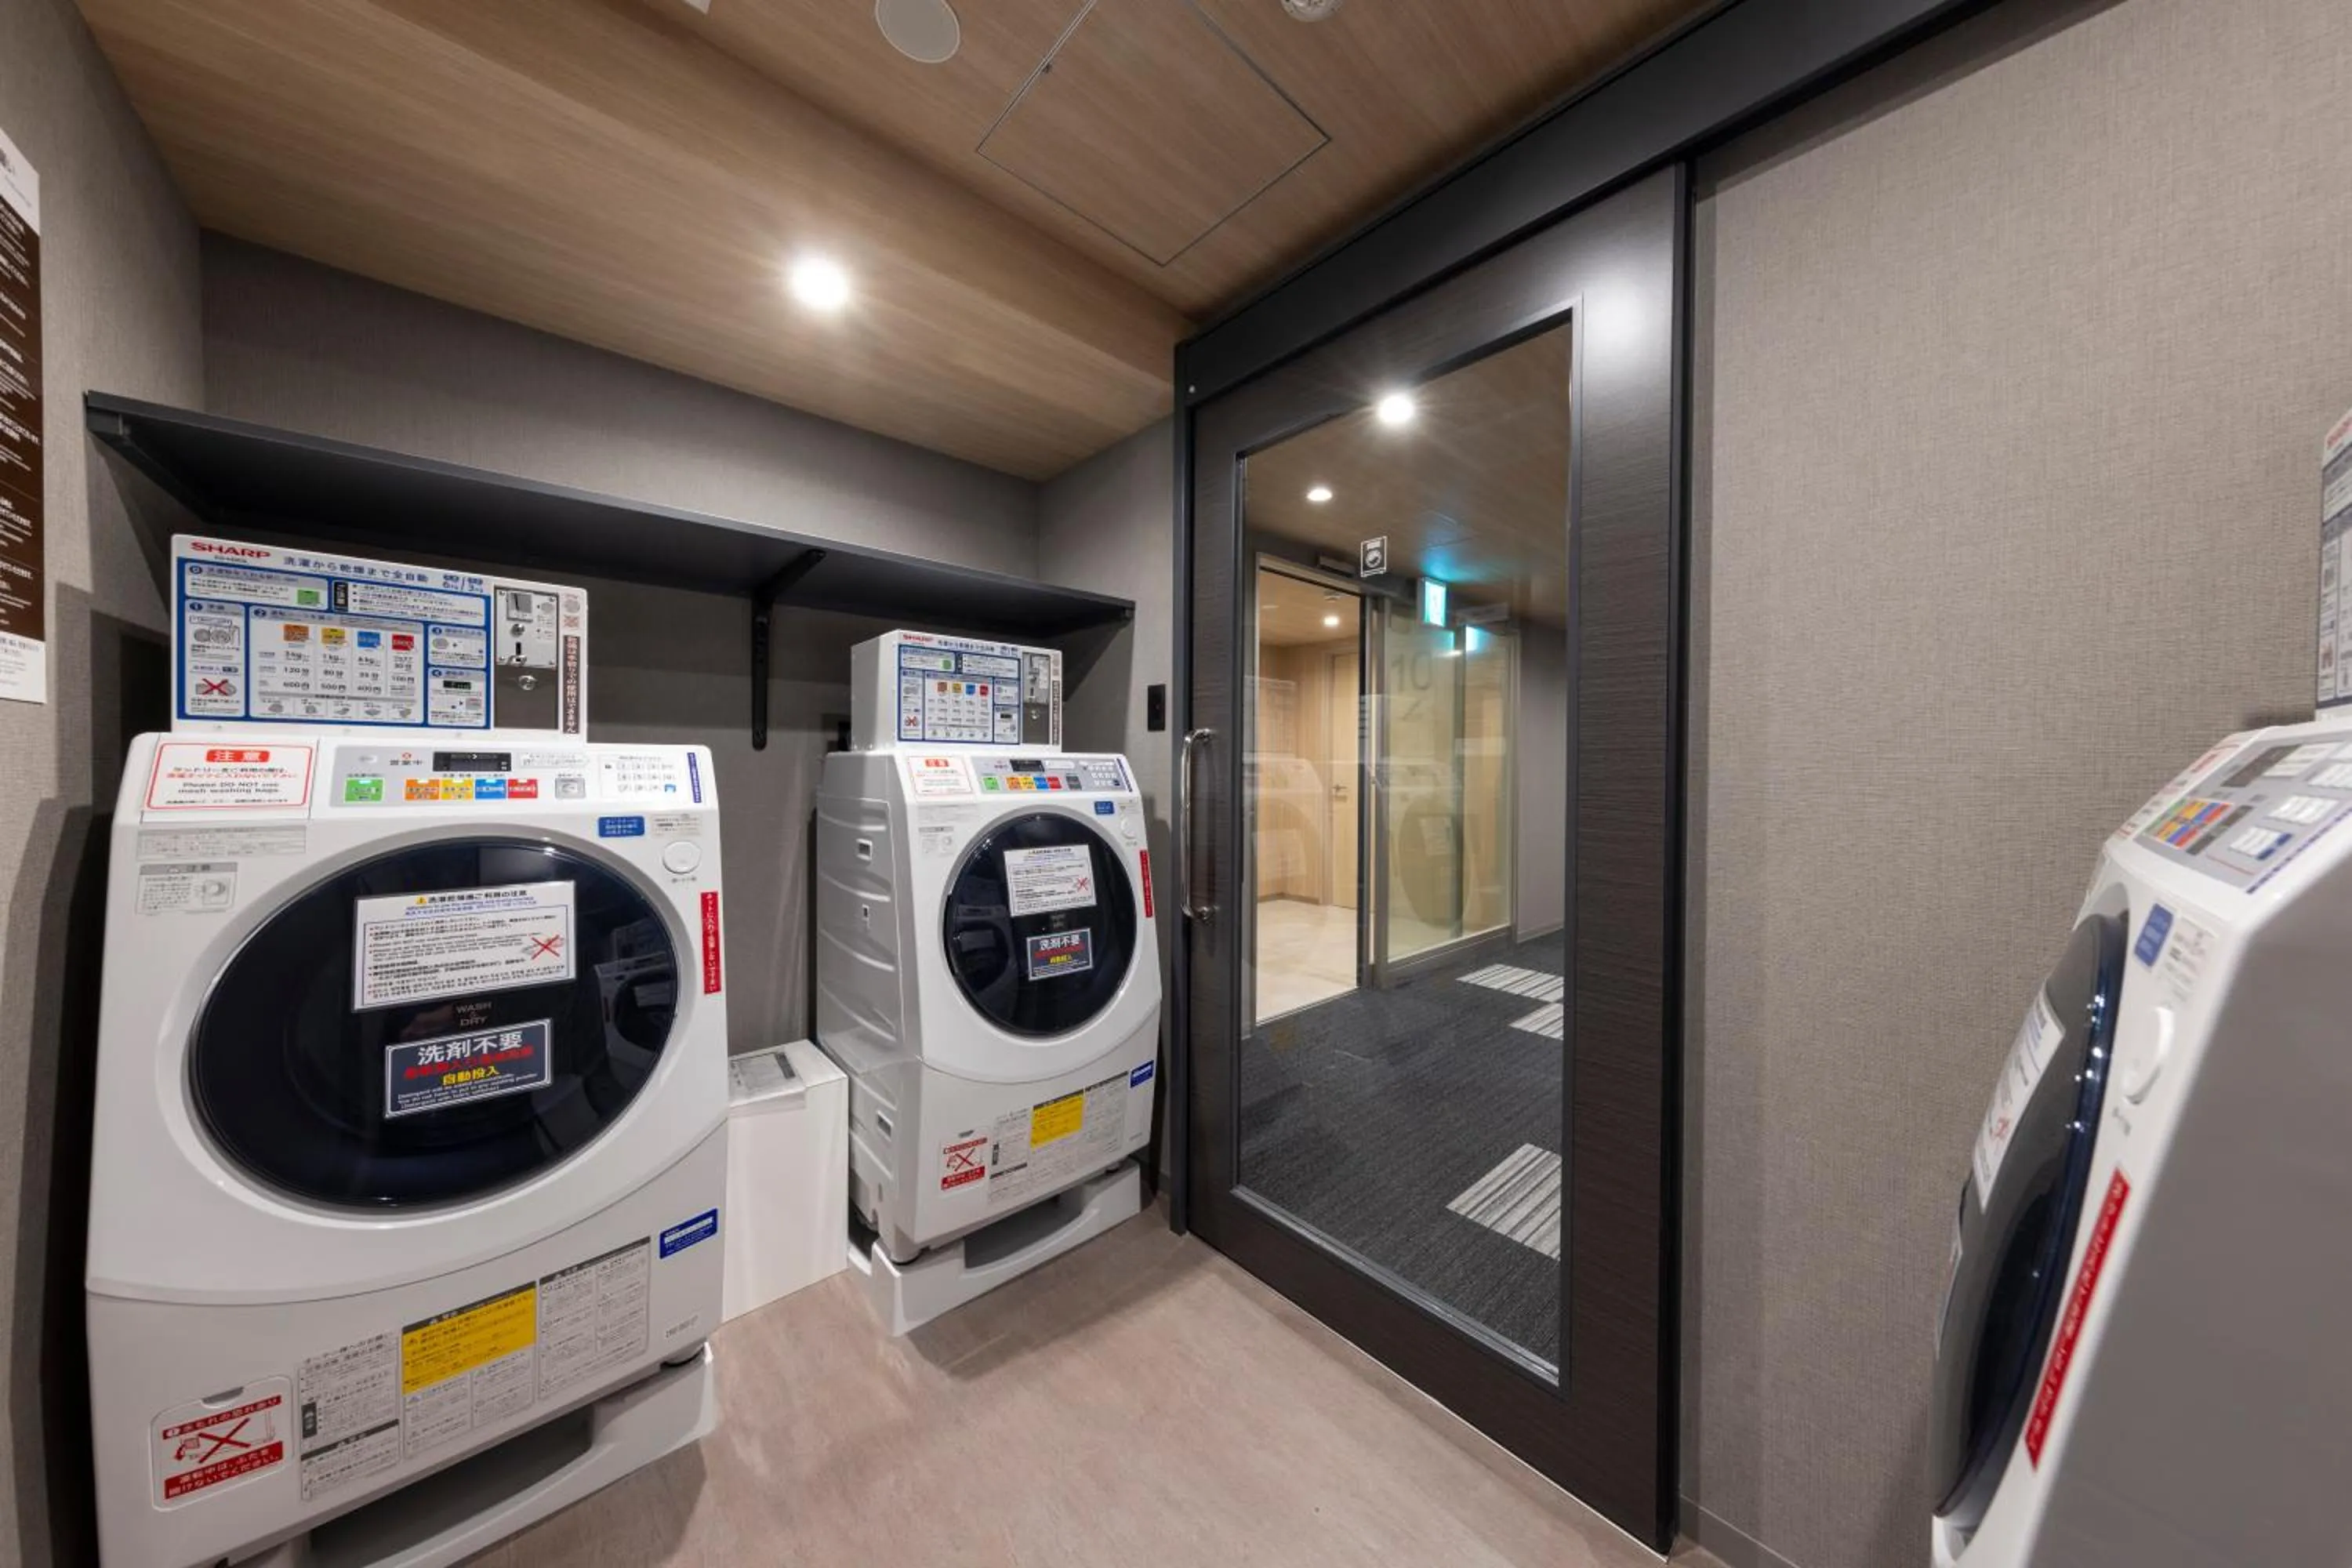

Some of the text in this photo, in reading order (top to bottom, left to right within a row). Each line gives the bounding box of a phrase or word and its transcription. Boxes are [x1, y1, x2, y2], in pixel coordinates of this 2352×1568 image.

[191, 541, 270, 558] SHARP
[214, 751, 263, 762] 注意
[456, 1002, 492, 1014] WASH
[460, 1016, 488, 1026] DRY
[418, 1031, 523, 1065] 洗剤不要
[443, 1065, 499, 1085] 自動投入
